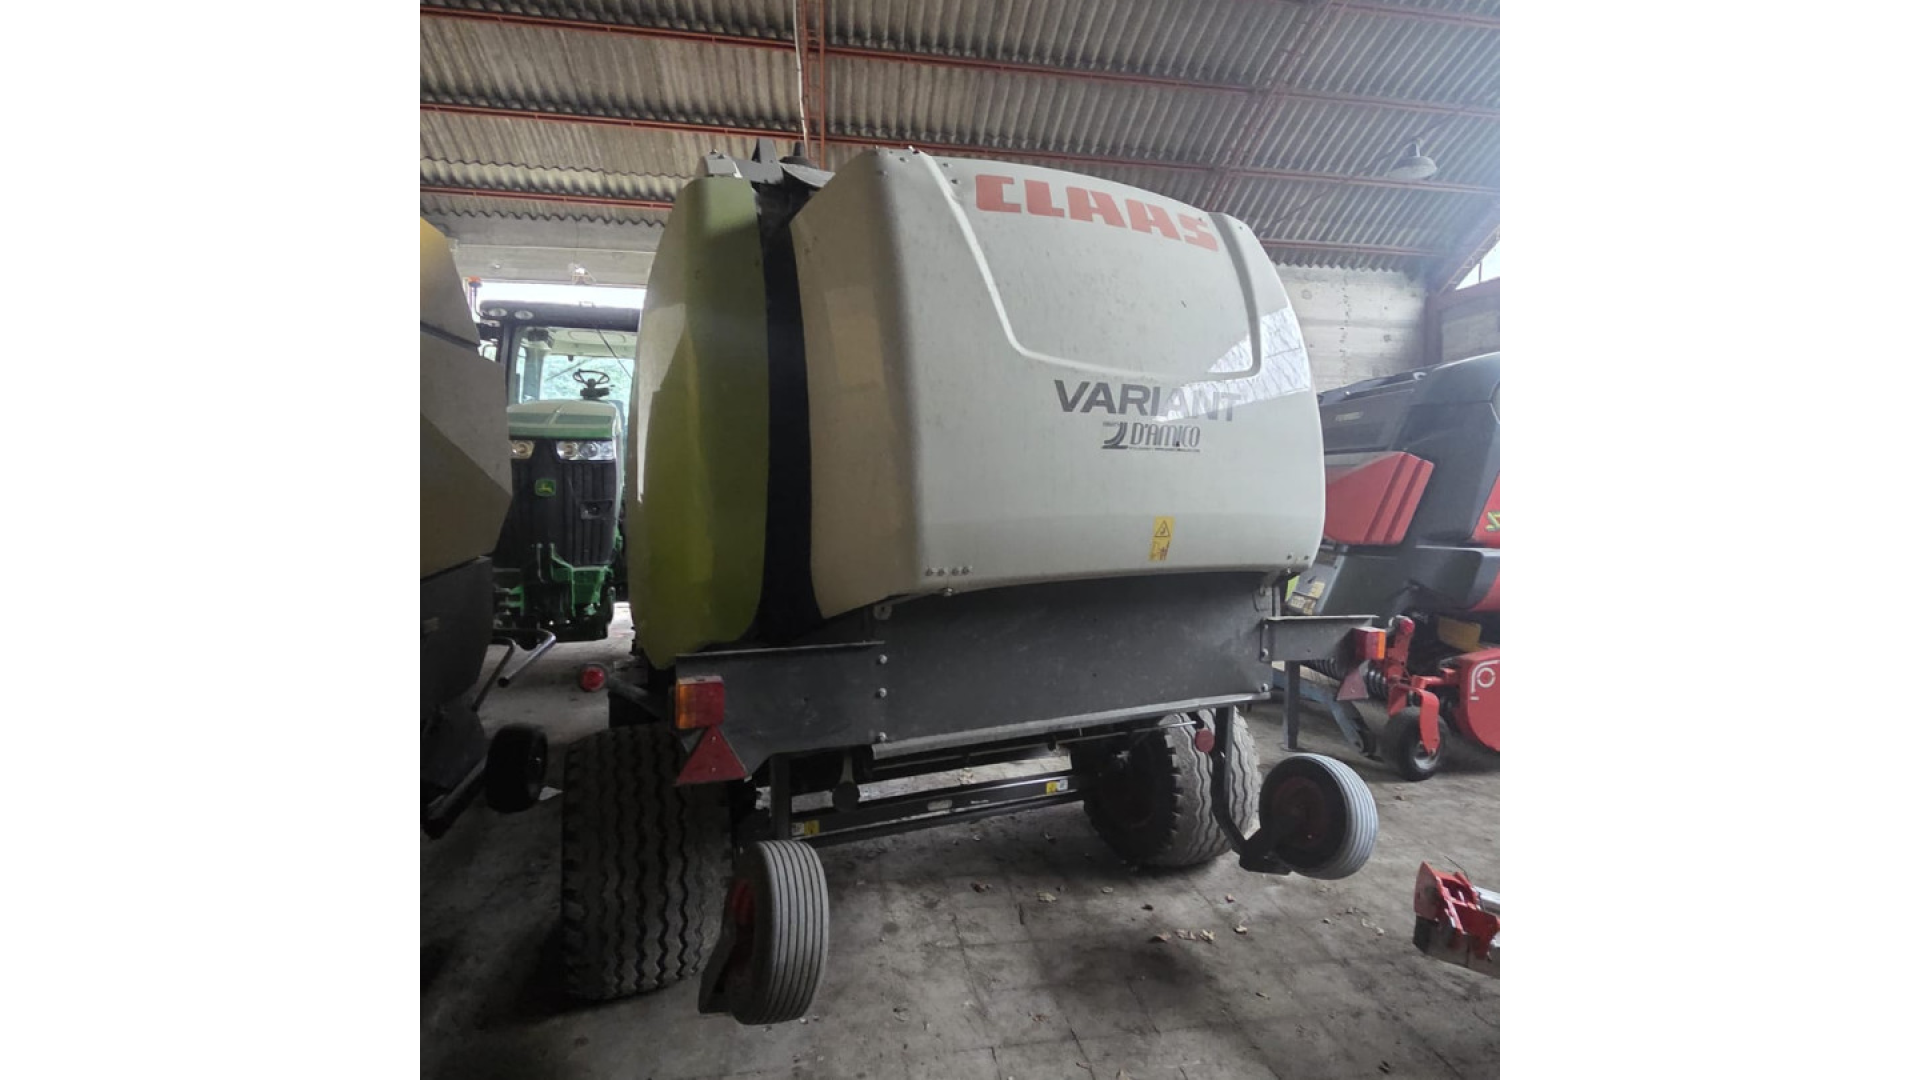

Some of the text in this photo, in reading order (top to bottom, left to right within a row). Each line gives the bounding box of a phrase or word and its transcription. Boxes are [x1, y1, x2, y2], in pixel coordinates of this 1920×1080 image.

[975, 174, 1219, 252] CLAAS
[1054, 379, 1242, 422] VARIANT
[1130, 422, 1201, 448] D'AMICO
